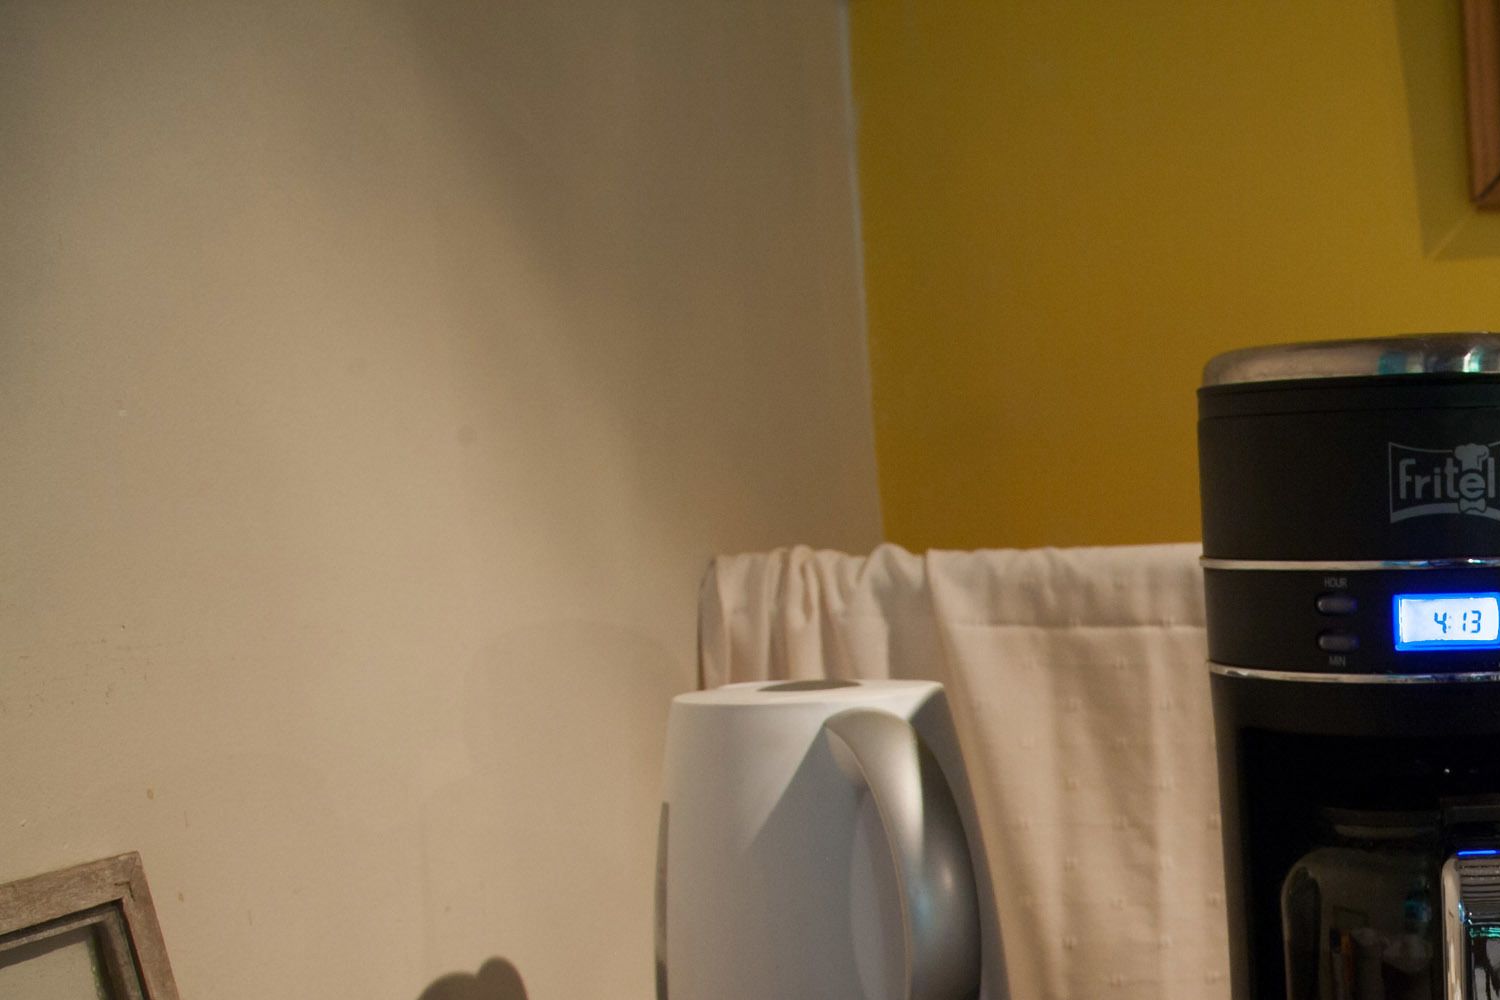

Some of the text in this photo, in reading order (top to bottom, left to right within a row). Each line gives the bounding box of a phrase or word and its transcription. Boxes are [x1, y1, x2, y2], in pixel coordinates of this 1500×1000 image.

[1324, 576, 1348, 588] HOUR
[1433, 610, 1482, 634] 4:13
[1329, 655, 1346, 667] MIN
